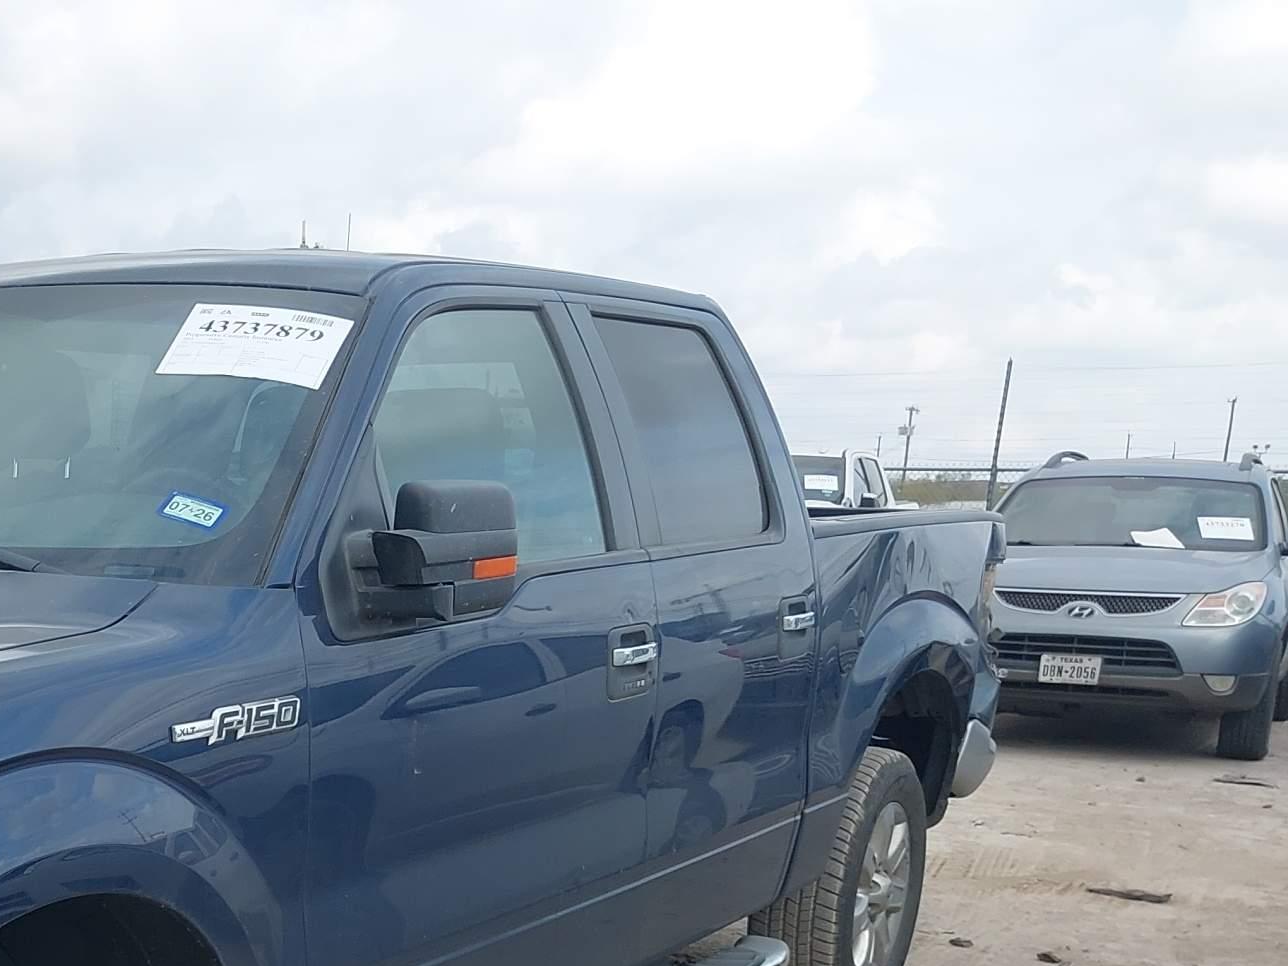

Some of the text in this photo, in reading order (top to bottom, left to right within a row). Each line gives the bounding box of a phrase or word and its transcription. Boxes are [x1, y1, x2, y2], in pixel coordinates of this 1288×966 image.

[198, 319, 325, 342] 43737879
[168, 501, 190, 513] 07
[193, 508, 215, 522] 26
[1059, 656, 1084, 664] TEXAS
[177, 696, 301, 742] XLT F-150
